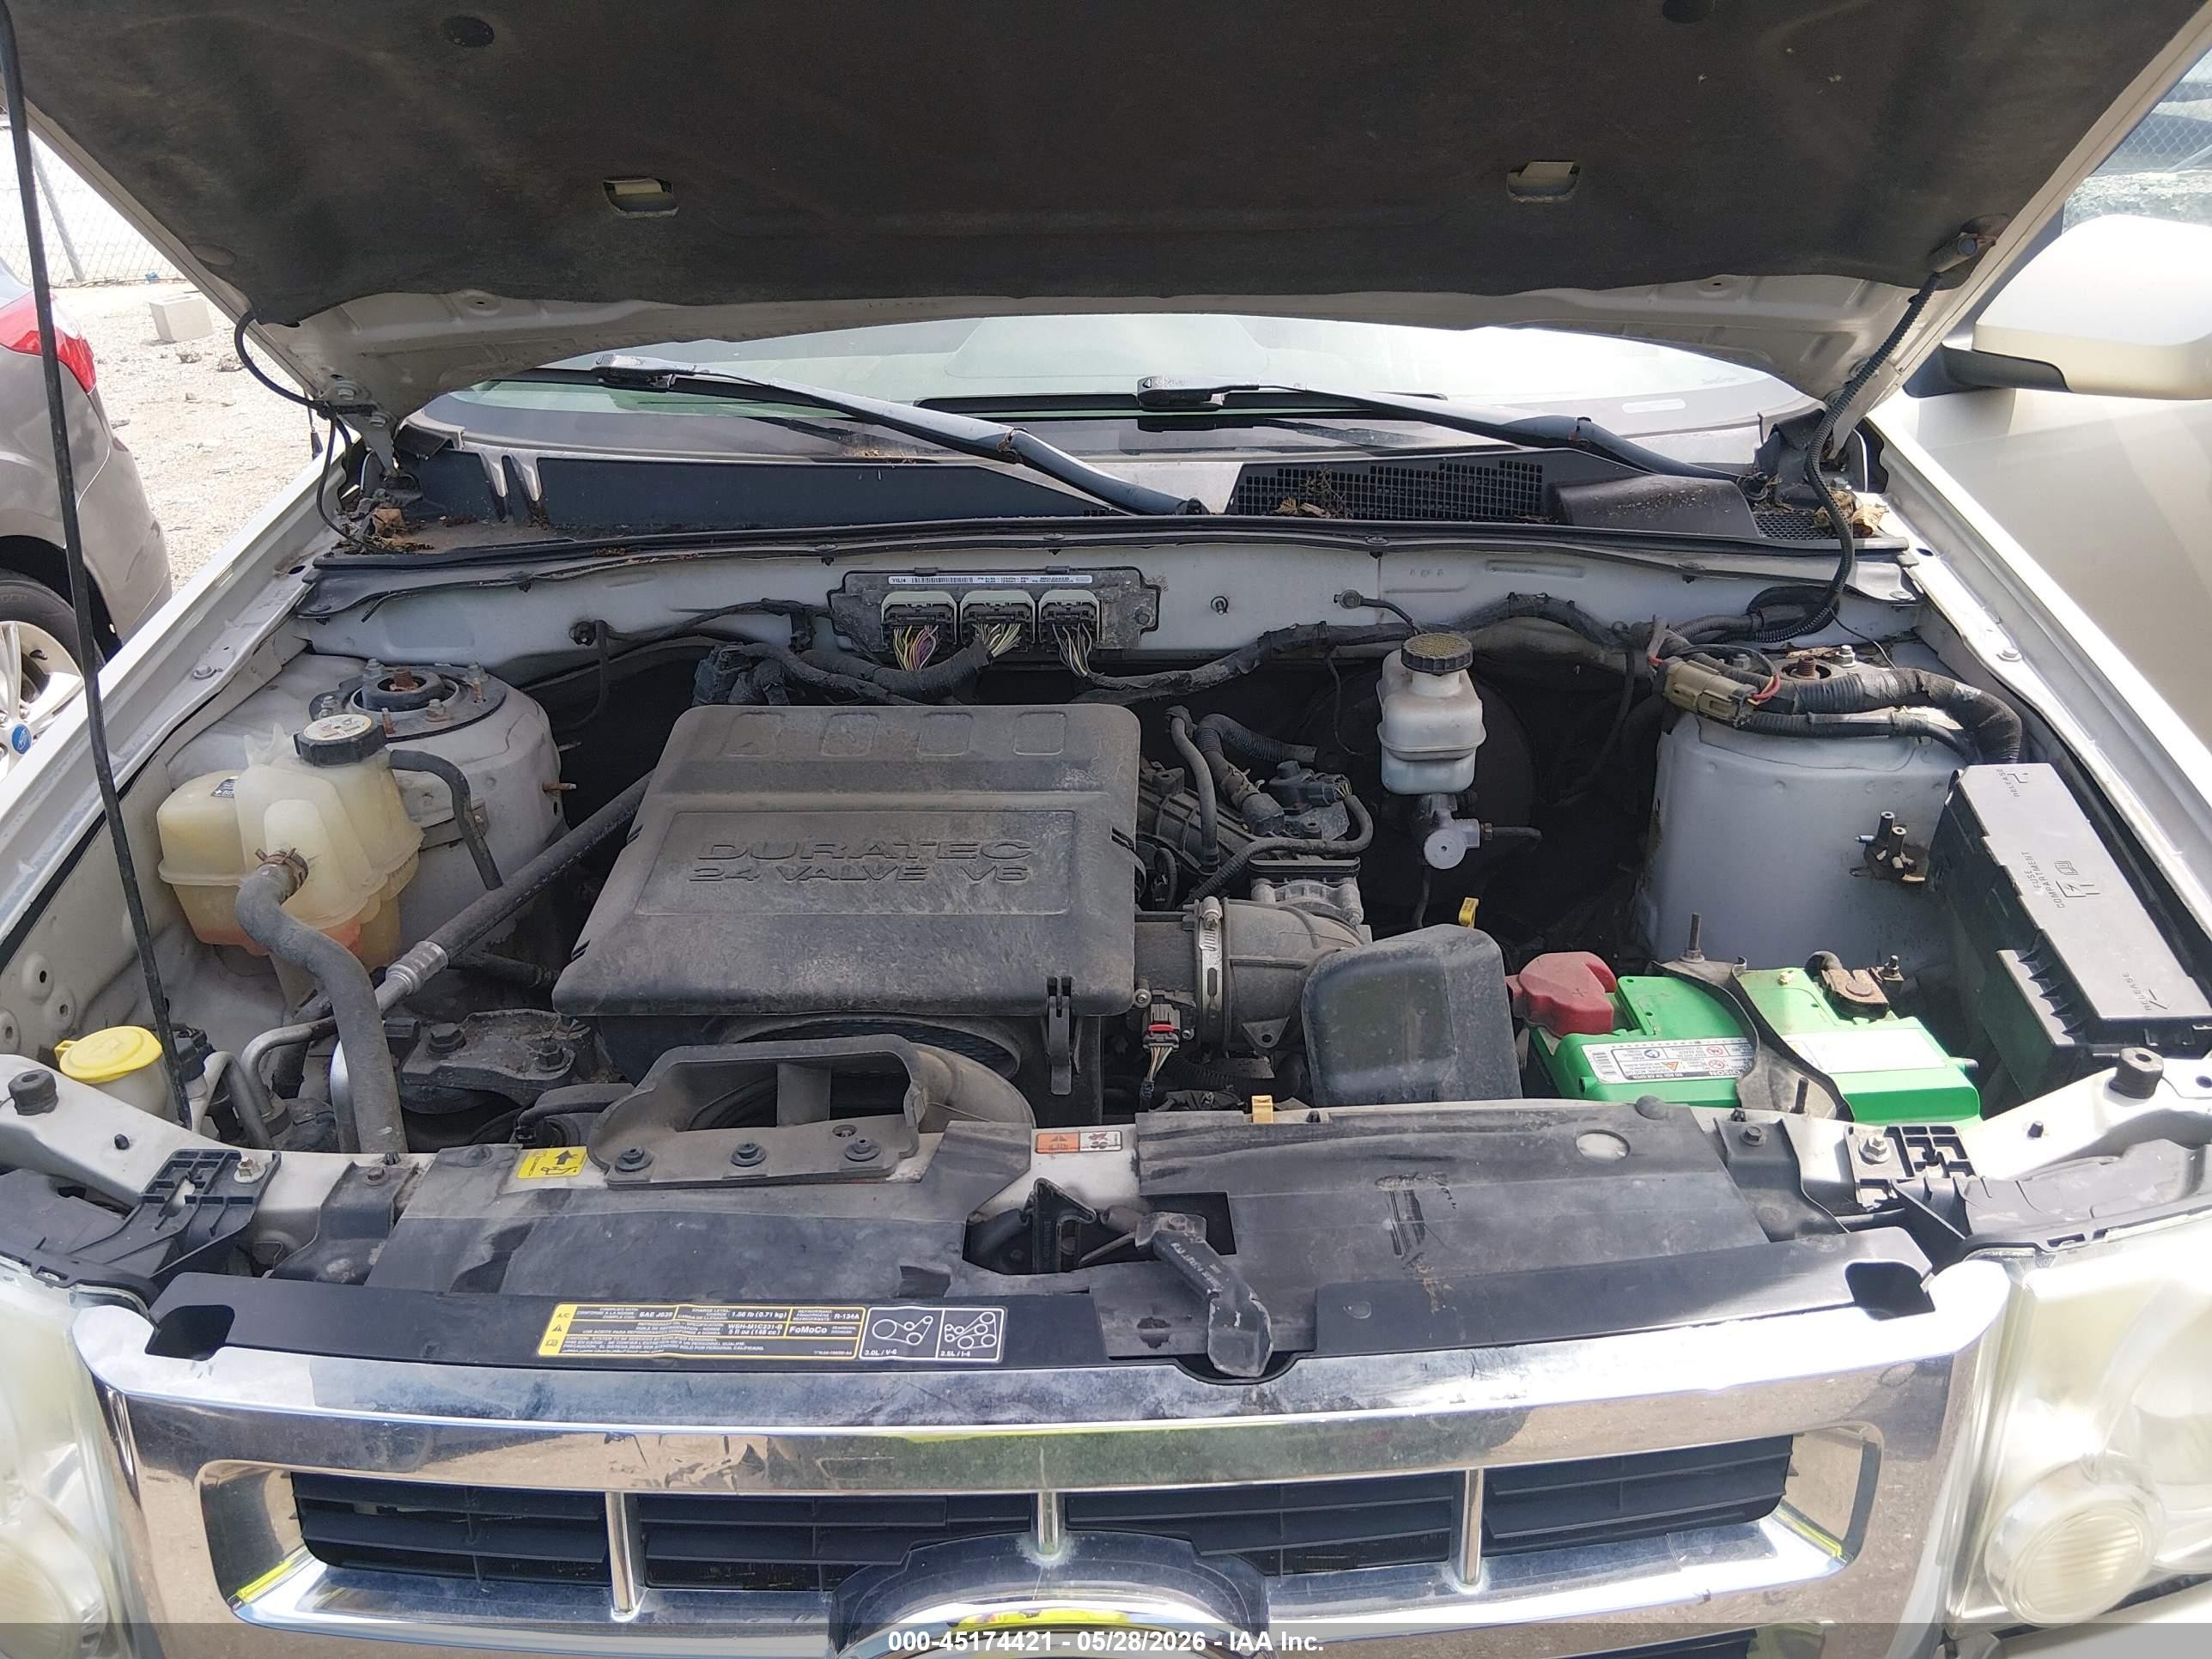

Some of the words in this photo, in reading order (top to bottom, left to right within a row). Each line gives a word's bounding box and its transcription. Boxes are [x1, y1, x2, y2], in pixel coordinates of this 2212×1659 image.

[697, 841, 1031, 860] DURATEC
[689, 866, 762, 883] 24
[775, 866, 931, 883] VALVE
[958, 866, 1030, 883] V6
[2021, 851, 2065, 908] COMPARTMENT
[2023, 870, 2042, 888] FUSE
